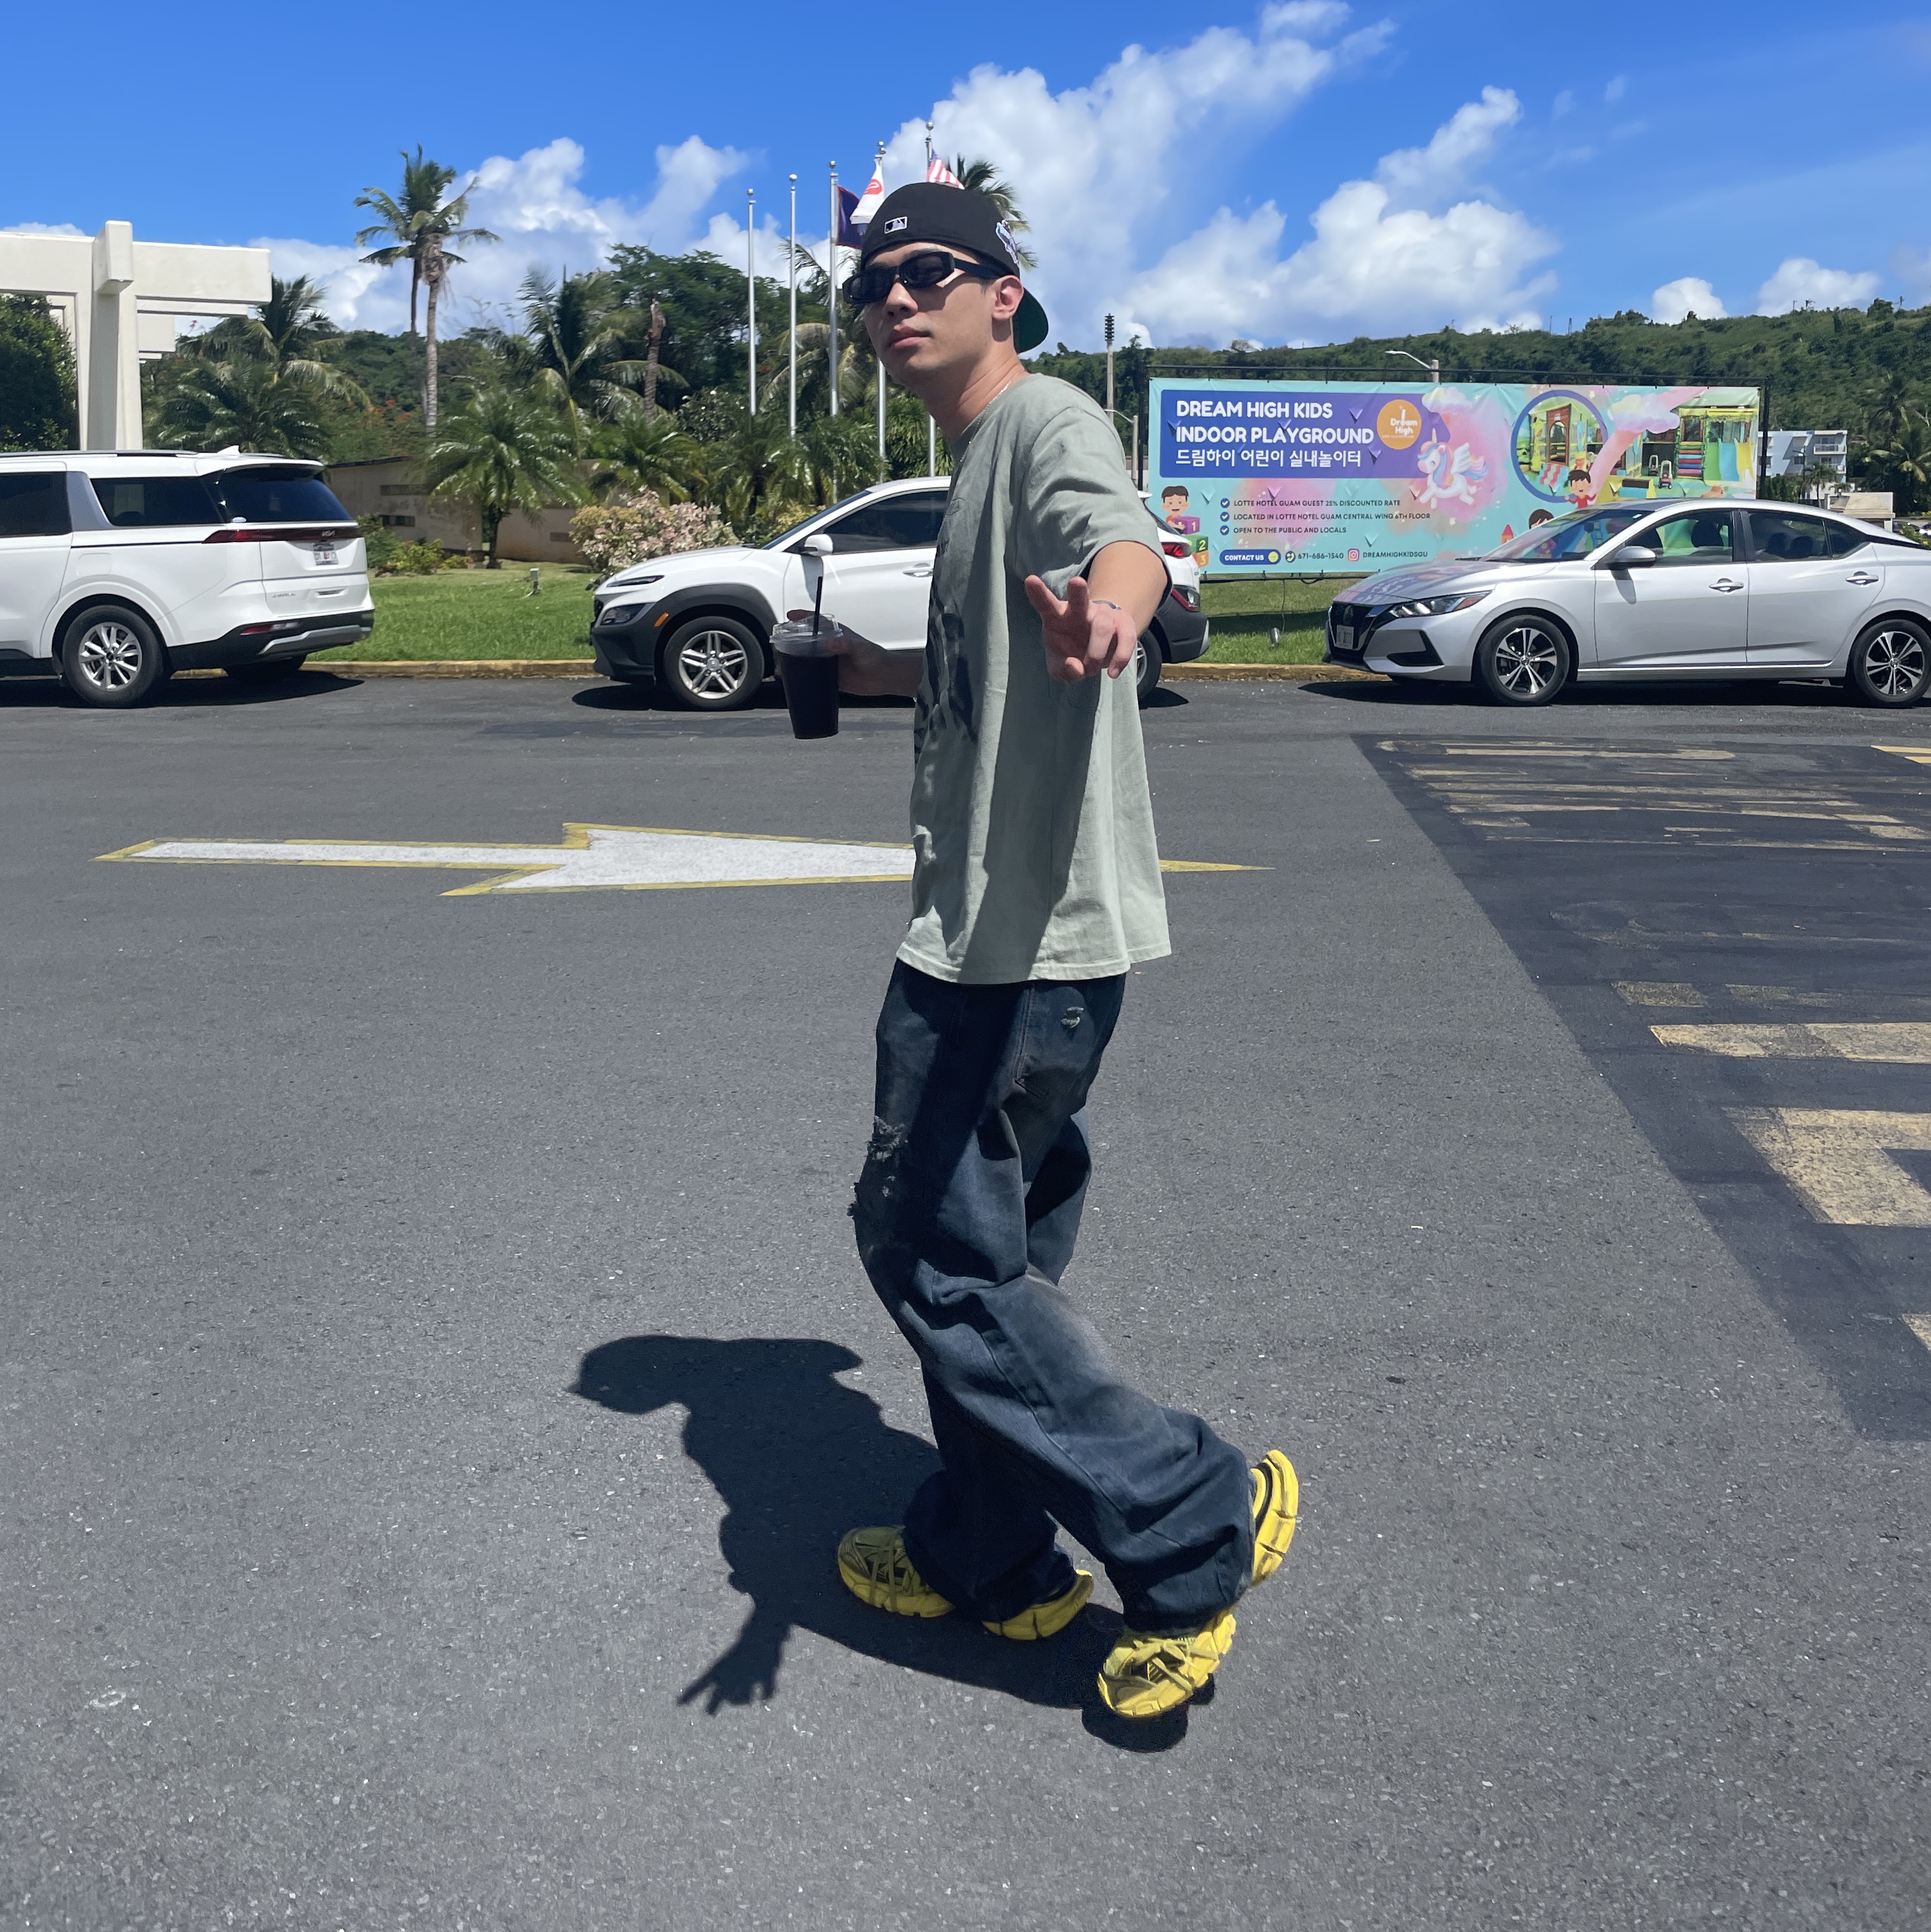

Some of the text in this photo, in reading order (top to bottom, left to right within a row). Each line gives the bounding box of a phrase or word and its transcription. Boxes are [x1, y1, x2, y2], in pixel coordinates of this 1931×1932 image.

[1176, 400, 1333, 418] DREAM HIGH KIDS
[1390, 417, 1417, 426] Dream
[1176, 426, 1374, 444] INDOOR PLAYGROUND
[1395, 426, 1414, 436] High
[1175, 449, 1362, 468] 드림하이 어린이 실내놀이터
[1191, 521, 1196, 531] 1
[1198, 540, 1206, 551] 2
[1200, 554, 1206, 565] 3
